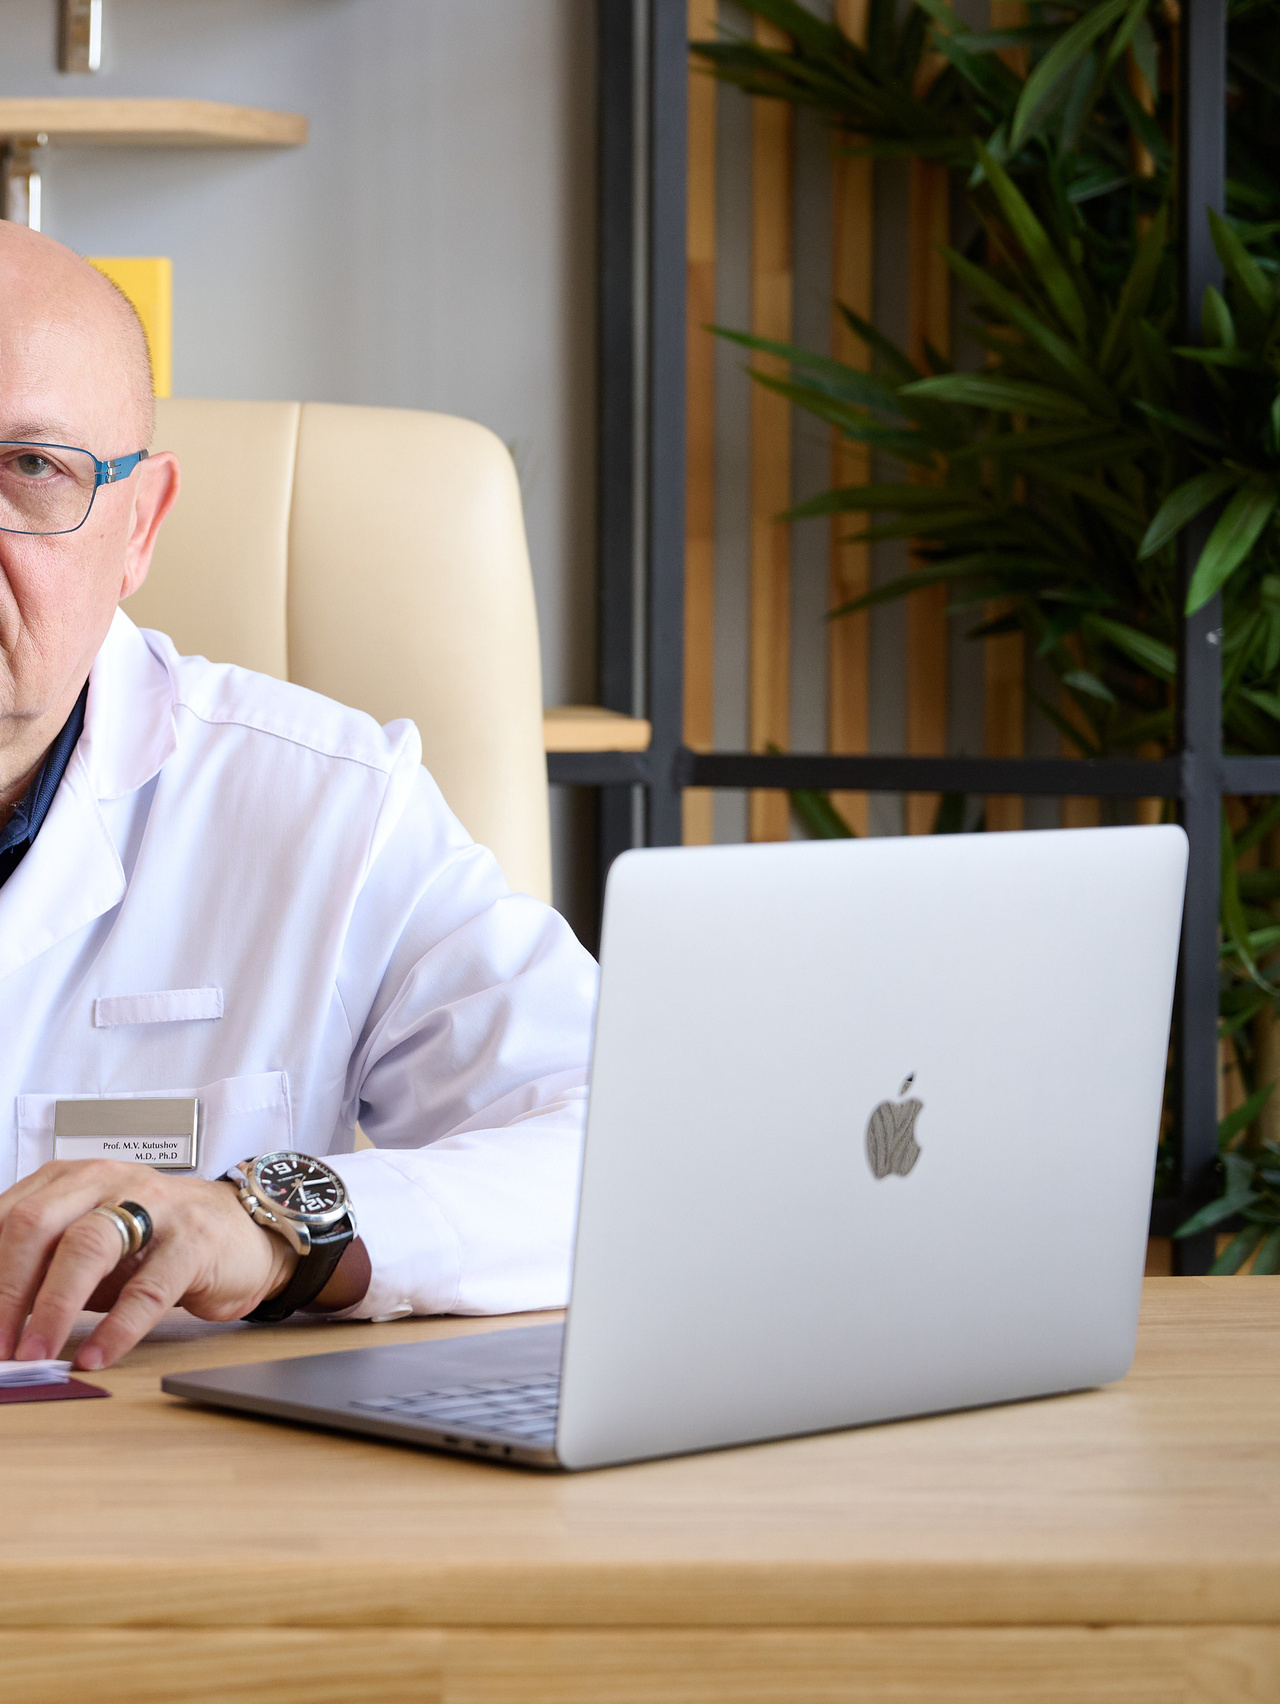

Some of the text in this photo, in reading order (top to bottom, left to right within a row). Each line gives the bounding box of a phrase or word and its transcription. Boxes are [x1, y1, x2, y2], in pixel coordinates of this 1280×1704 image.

[103, 1140, 179, 1150] Prof. M.V. Kutushov
[158, 1151, 178, 1160] Ph.D
